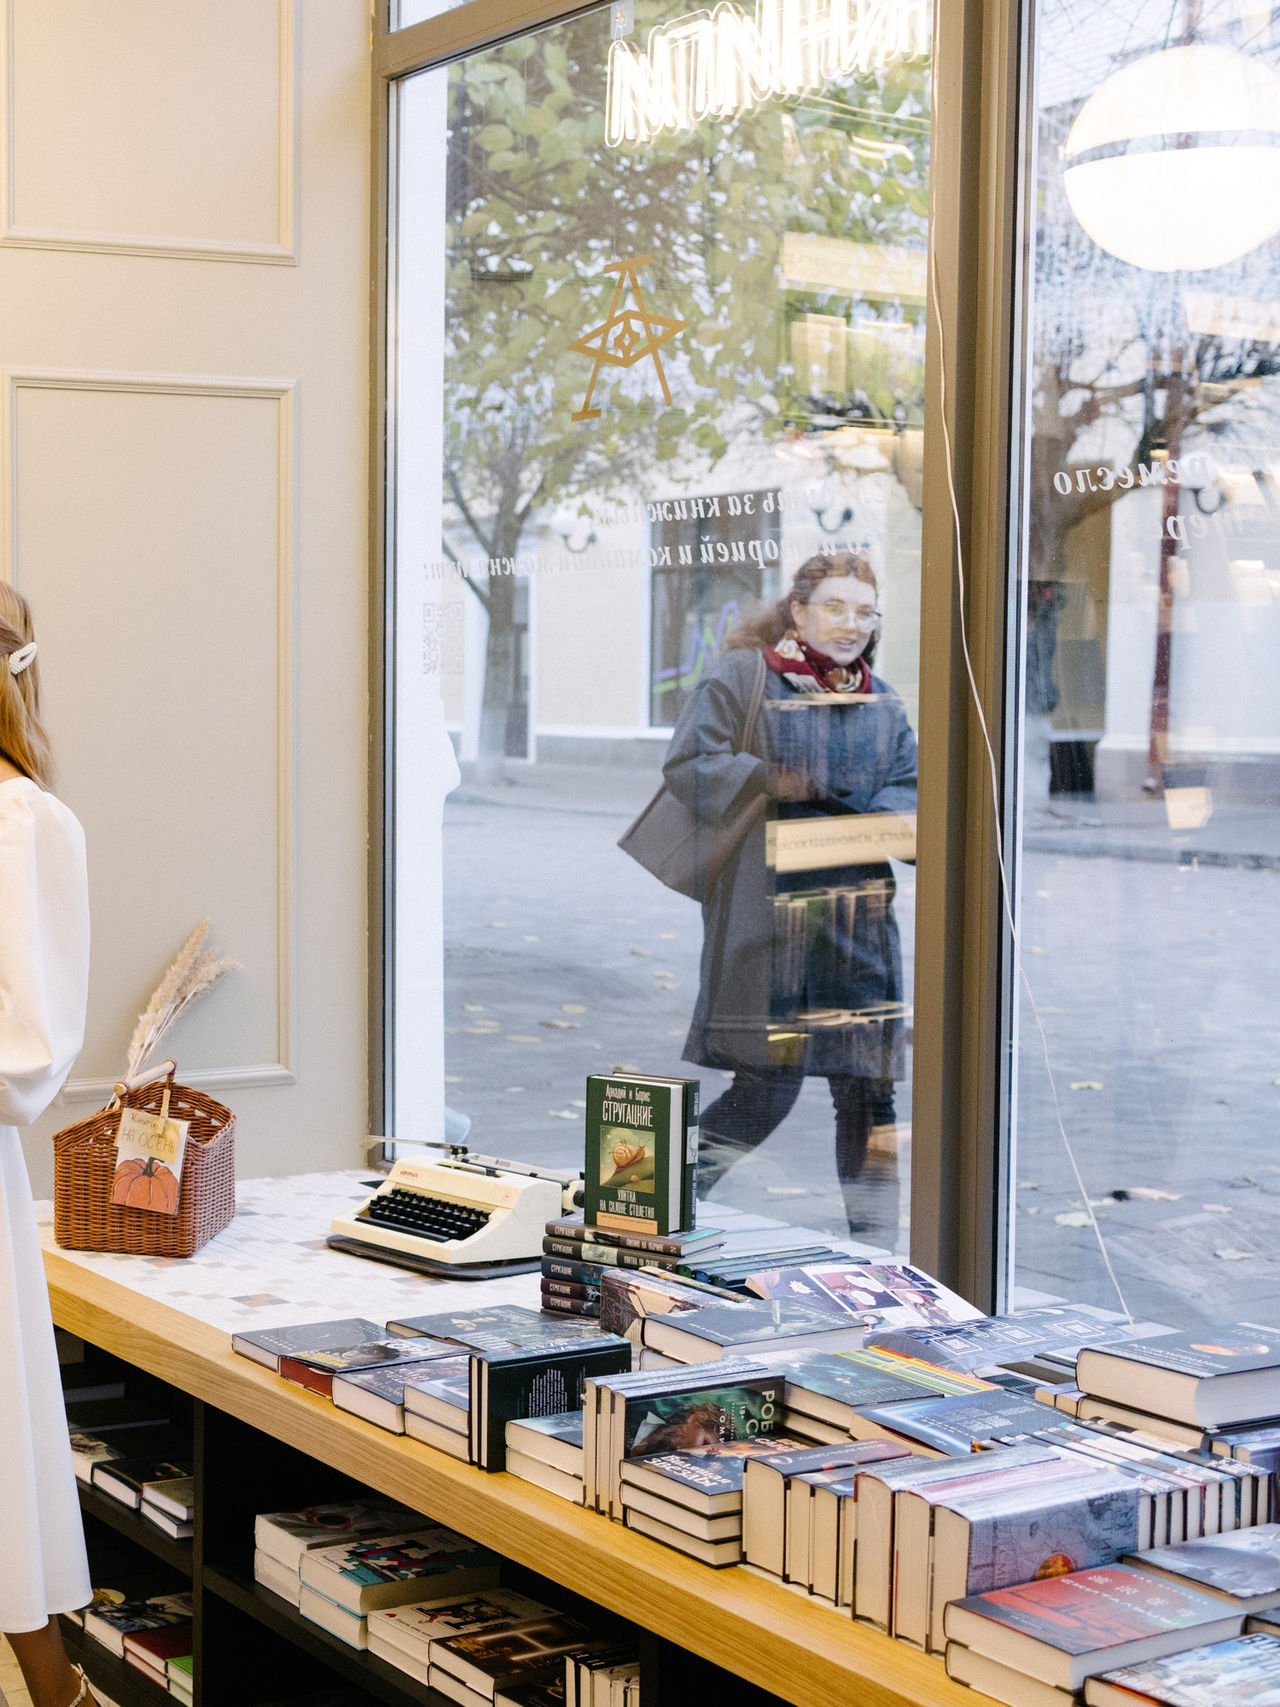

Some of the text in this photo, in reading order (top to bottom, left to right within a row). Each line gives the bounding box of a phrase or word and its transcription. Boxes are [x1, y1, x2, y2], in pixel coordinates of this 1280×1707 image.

[605, 1083, 651, 1104] Аркадий и Борис
[131, 1113, 156, 1128] Книги
[602, 1100, 654, 1127] СТРУГАЦКИЕ
[139, 1132, 175, 1154] ОСЕНЬ
[617, 1189, 636, 1203] УЛИТКА
[600, 1200, 655, 1219] НА СКЛОНЕ СТОЛЕТИЯ
[554, 1226, 577, 1238] СТРУГАЦКИЕ
[551, 1243, 574, 1255] СТРУГАЦКИЕ
[550, 1264, 573, 1276] СТРУГАЦКИЕ
[549, 1283, 571, 1294] СТРУГАЦКИЕ
[550, 1297, 572, 1309] СТРУГАЦКИЕ
[1061, 1578, 1179, 1627] СКИТАЛЬЦЫ
